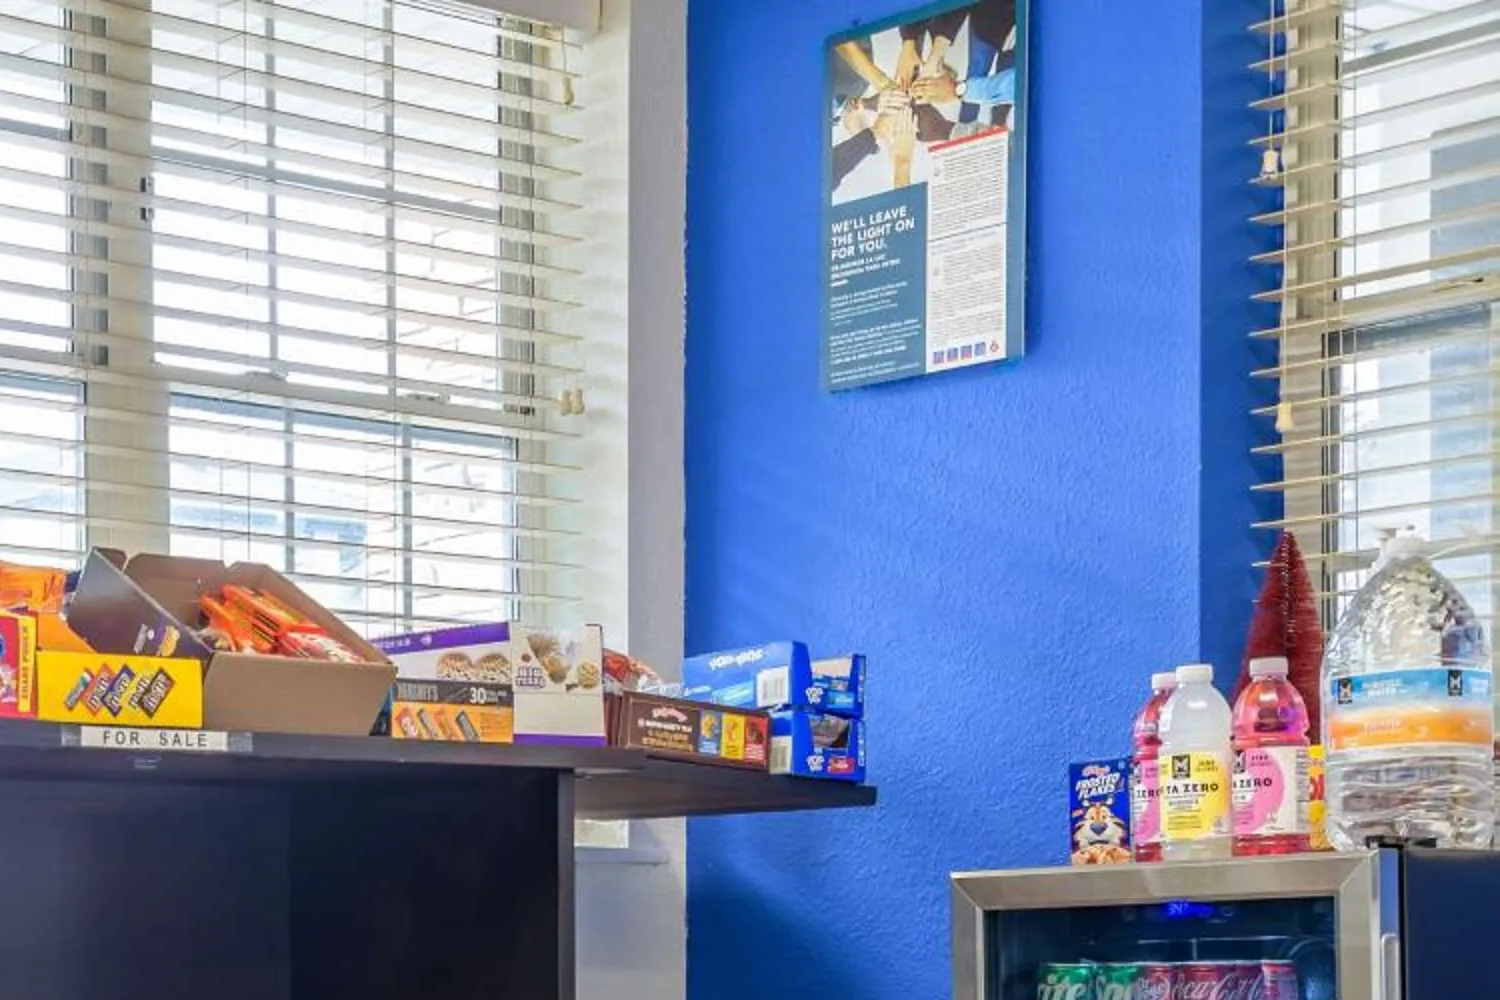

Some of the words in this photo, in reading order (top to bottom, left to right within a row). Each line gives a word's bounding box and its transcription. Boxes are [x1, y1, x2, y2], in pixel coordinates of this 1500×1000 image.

[831, 217, 866, 236] WE'LL
[869, 205, 907, 226] LEAVE
[831, 231, 854, 249] THE
[857, 224, 892, 245] LIGHT
[895, 217, 915, 233] ON
[831, 246, 855, 261] FOR
[469, 686, 487, 704] 30
[102, 730, 141, 746] FOR
[159, 732, 209, 748] SALE
[1184, 783, 1220, 793] ZERO
[1239, 777, 1272, 790] ZERO
